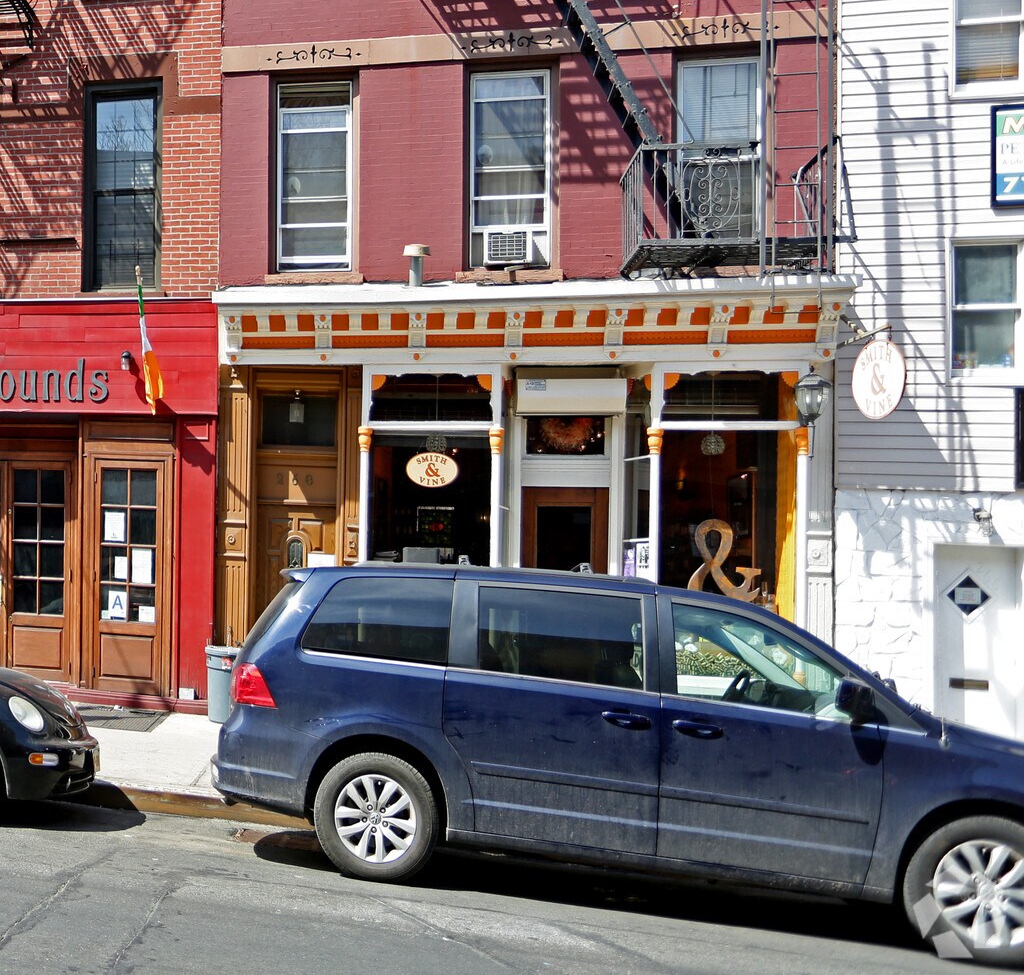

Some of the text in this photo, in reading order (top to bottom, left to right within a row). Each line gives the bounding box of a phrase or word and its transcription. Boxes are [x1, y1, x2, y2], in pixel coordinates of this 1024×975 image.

[1002, 115, 1024, 134] M
[1001, 143, 1024, 154] PE
[1003, 176, 1024, 194] 7
[860, 345, 892, 371] SMITH
[870, 362, 887, 396] &
[865, 393, 894, 416] VINE
[416, 454, 448, 466] SMITH
[425, 462, 441, 477] &
[419, 476, 447, 486] VINE
[111, 594, 124, 610] A
